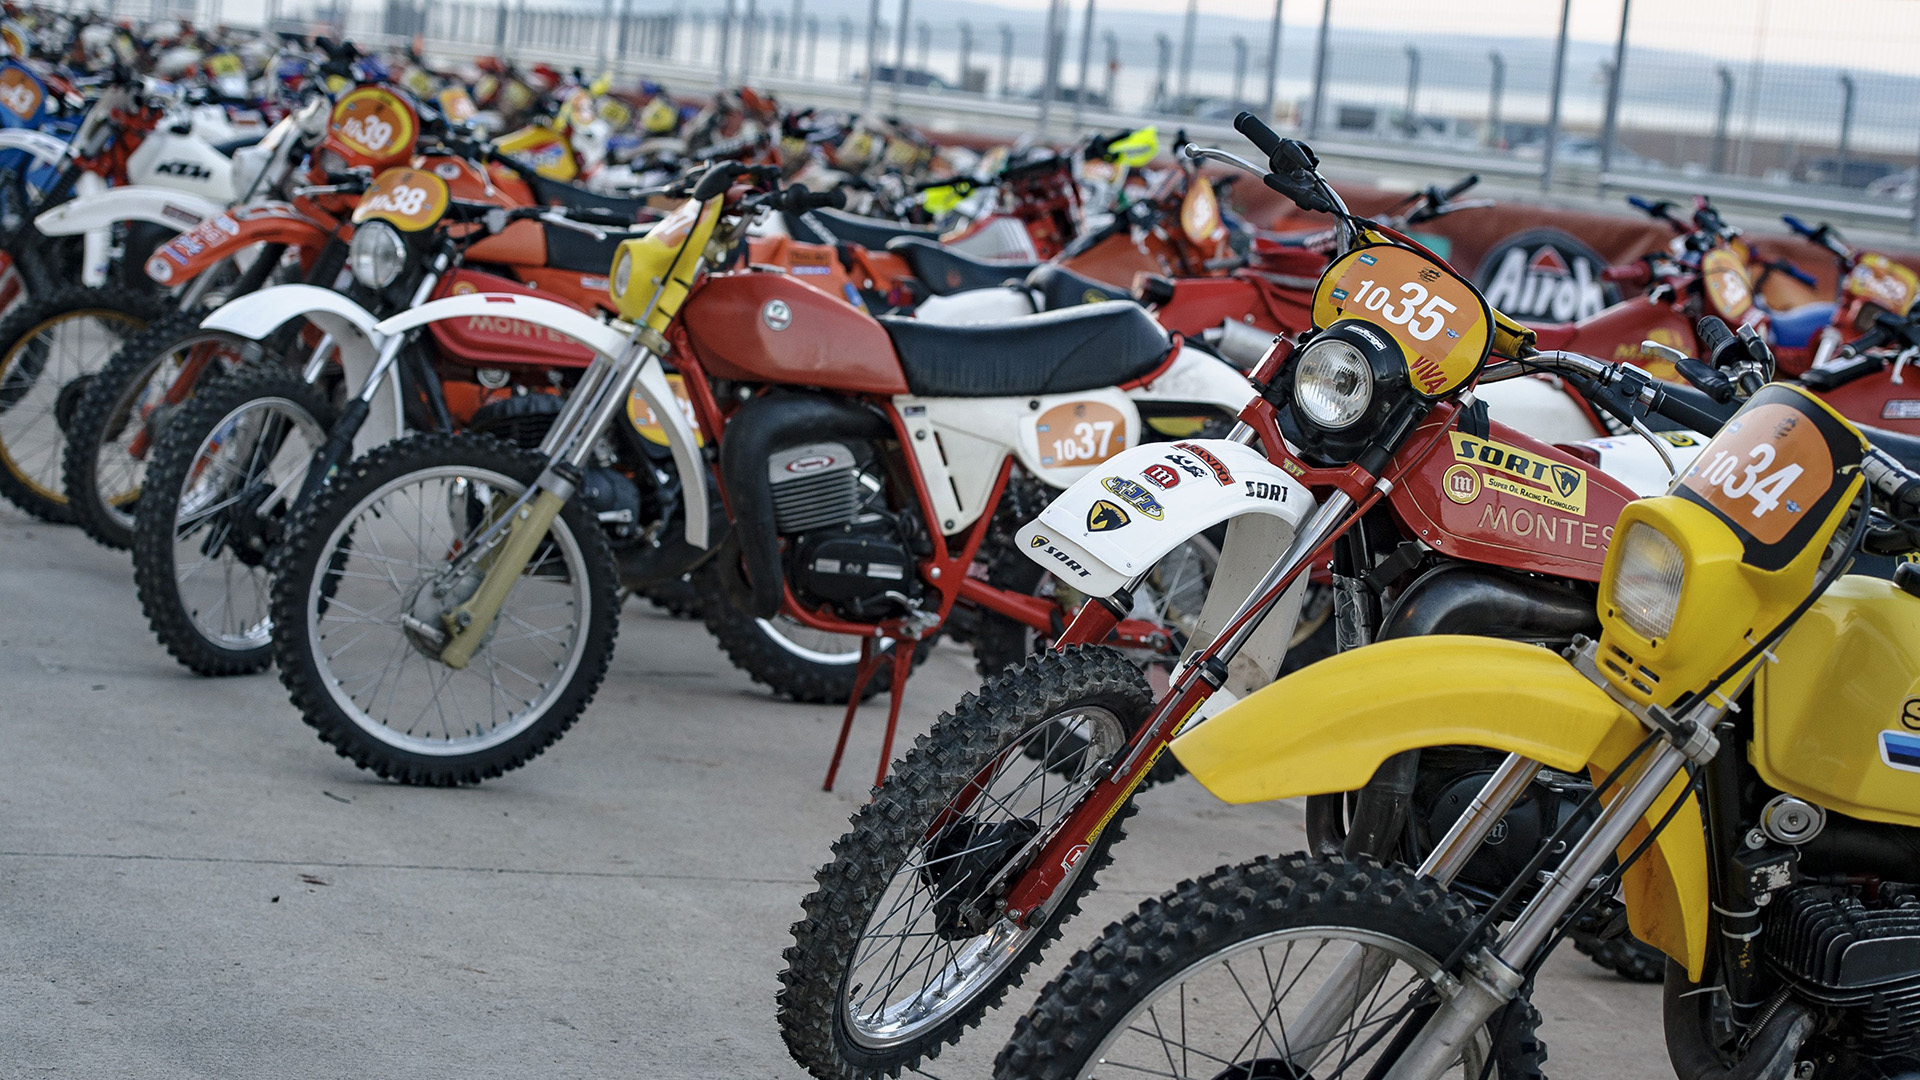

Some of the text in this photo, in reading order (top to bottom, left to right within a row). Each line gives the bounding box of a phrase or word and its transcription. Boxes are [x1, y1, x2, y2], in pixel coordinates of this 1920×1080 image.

[1486, 247, 1604, 322] Airoh
[1353, 279, 1458, 342] 1035
[1410, 356, 1448, 394] VIVA
[1053, 420, 1115, 461] 1037
[1456, 440, 1549, 481] SORT
[1283, 458, 1306, 477] TJT
[1701, 443, 1804, 518] 1034
[1112, 476, 1164, 512] TJT
[1245, 481, 1288, 503] SORT
[1478, 503, 1615, 552] MONTES
[1044, 545, 1092, 579] SORT
